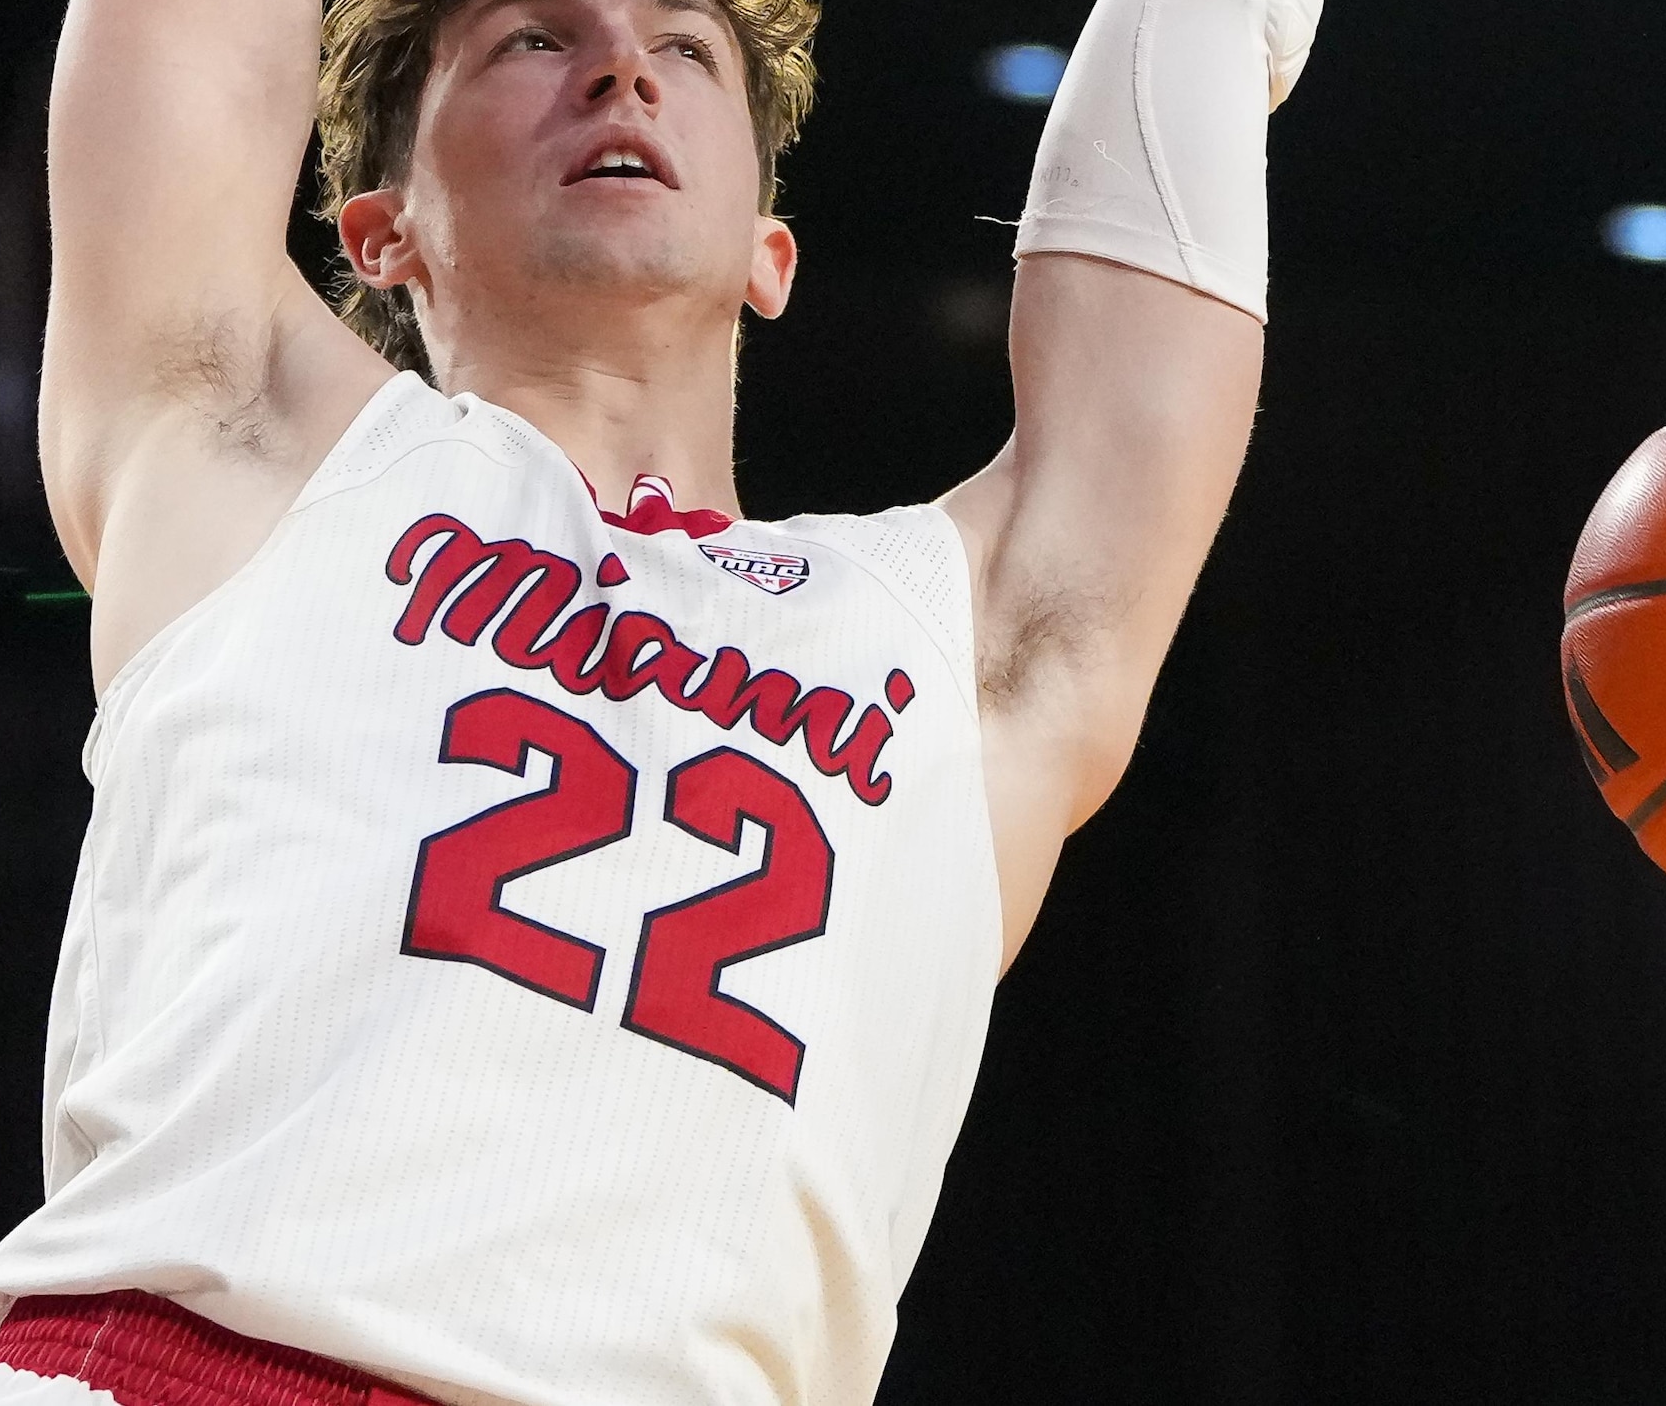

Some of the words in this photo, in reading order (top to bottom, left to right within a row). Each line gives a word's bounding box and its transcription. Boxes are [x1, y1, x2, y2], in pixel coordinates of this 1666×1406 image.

[385, 513, 915, 806] Miami
[713, 556, 809, 579] MAC
[400, 687, 835, 1110] 22
